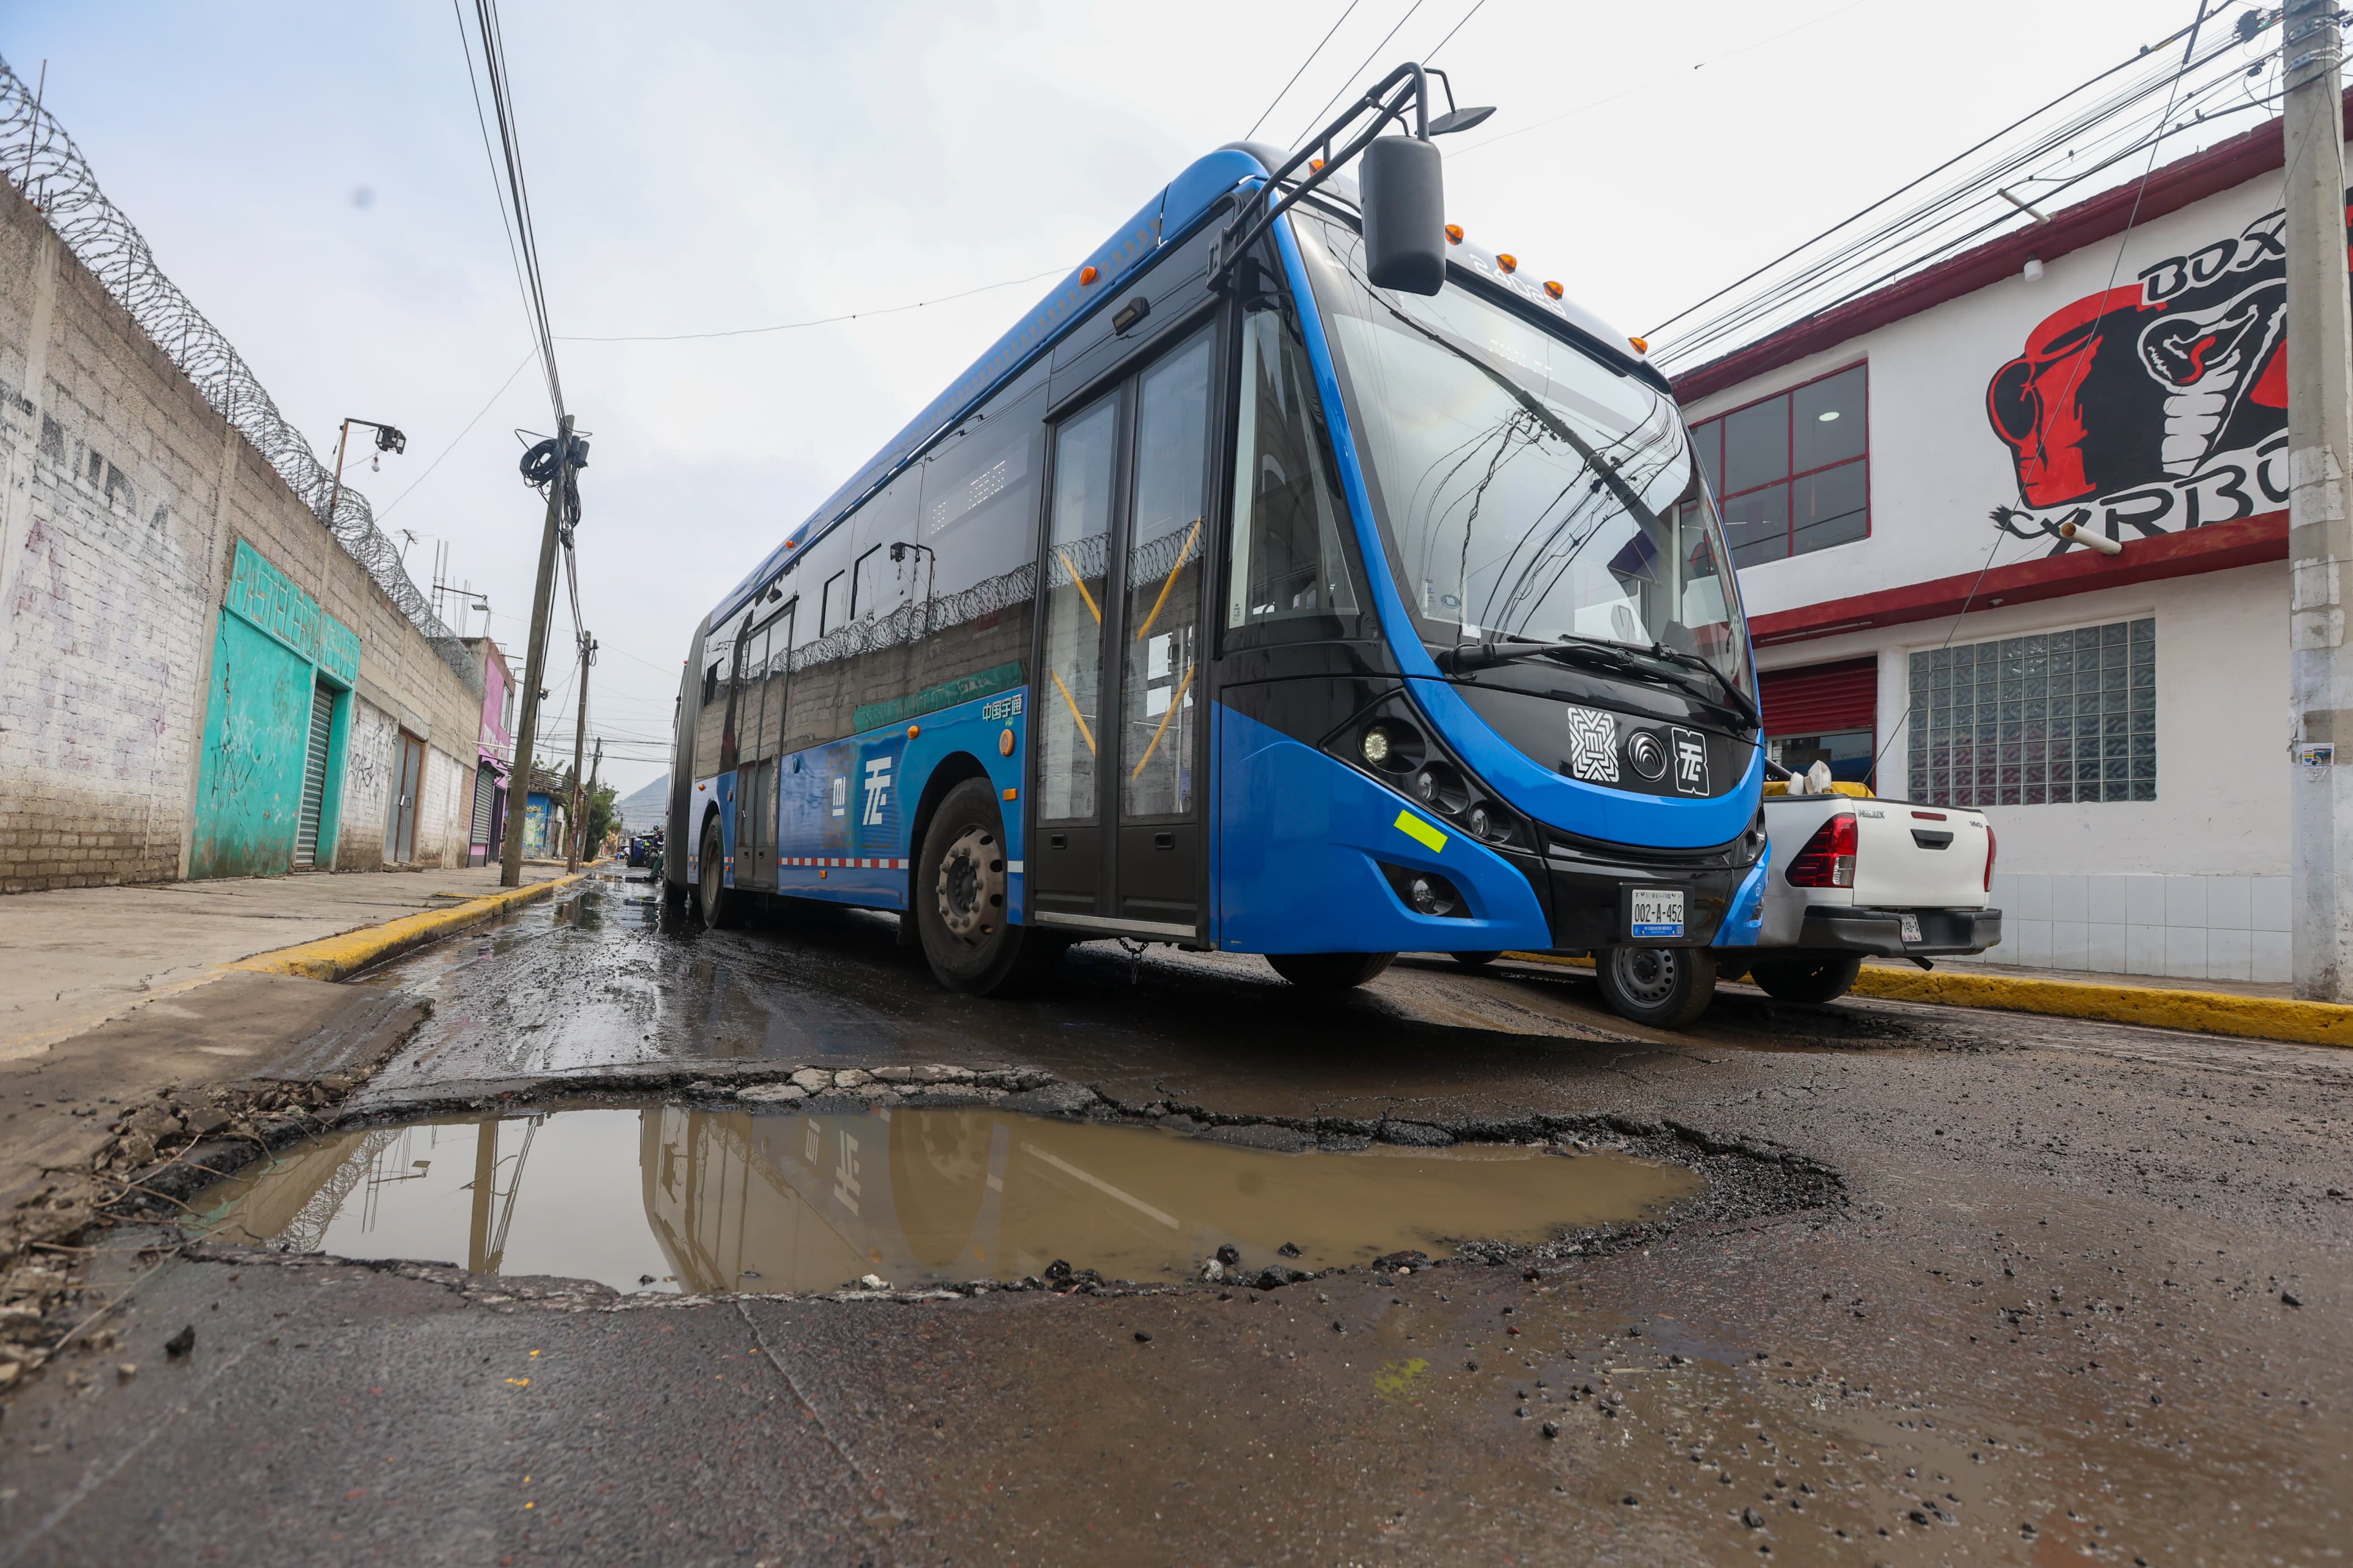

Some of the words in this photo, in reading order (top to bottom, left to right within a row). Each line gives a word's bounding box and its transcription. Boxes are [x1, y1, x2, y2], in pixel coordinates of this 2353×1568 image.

[2138, 208, 2286, 301] BOX
[982, 694, 1023, 722] 中国宇通
[1635, 903, 1682, 922] 002-A-452
